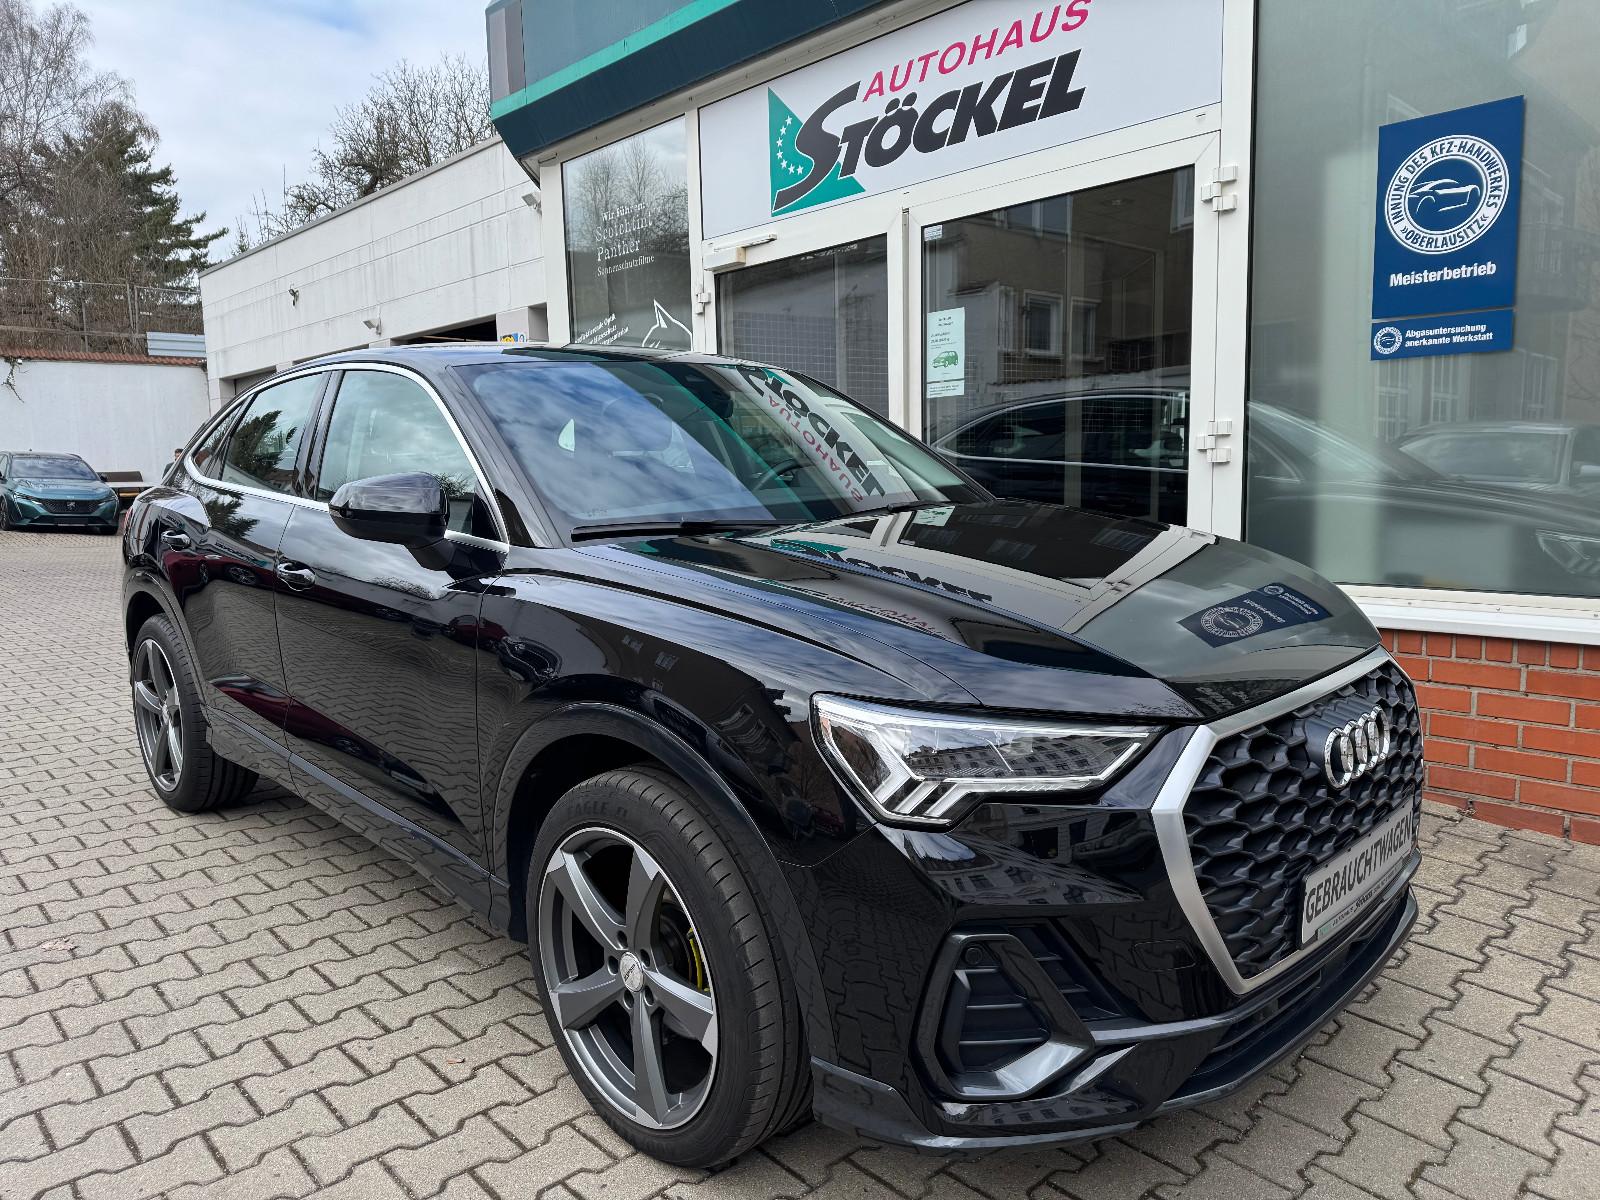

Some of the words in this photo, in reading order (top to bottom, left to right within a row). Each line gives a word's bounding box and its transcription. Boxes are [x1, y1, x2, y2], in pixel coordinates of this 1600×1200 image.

[863, 0, 1091, 102] AUTOHAUS
[772, 49, 1087, 212] STÖCKEL
[1390, 175, 1408, 225] INNUNG
[1404, 152, 1428, 175] DES
[1430, 140, 1503, 209] KFZ-HANDWERKES
[597, 240, 641, 262] Panther
[1389, 261, 1497, 287] Meisterbetrieb
[1405, 324, 1487, 338] Abgasuntersuchung
[1405, 337, 1451, 348] anerkannte
[1452, 332, 1494, 344] Werkstatt
[1305, 811, 1413, 924] GEBRAUCHTWAGEN
